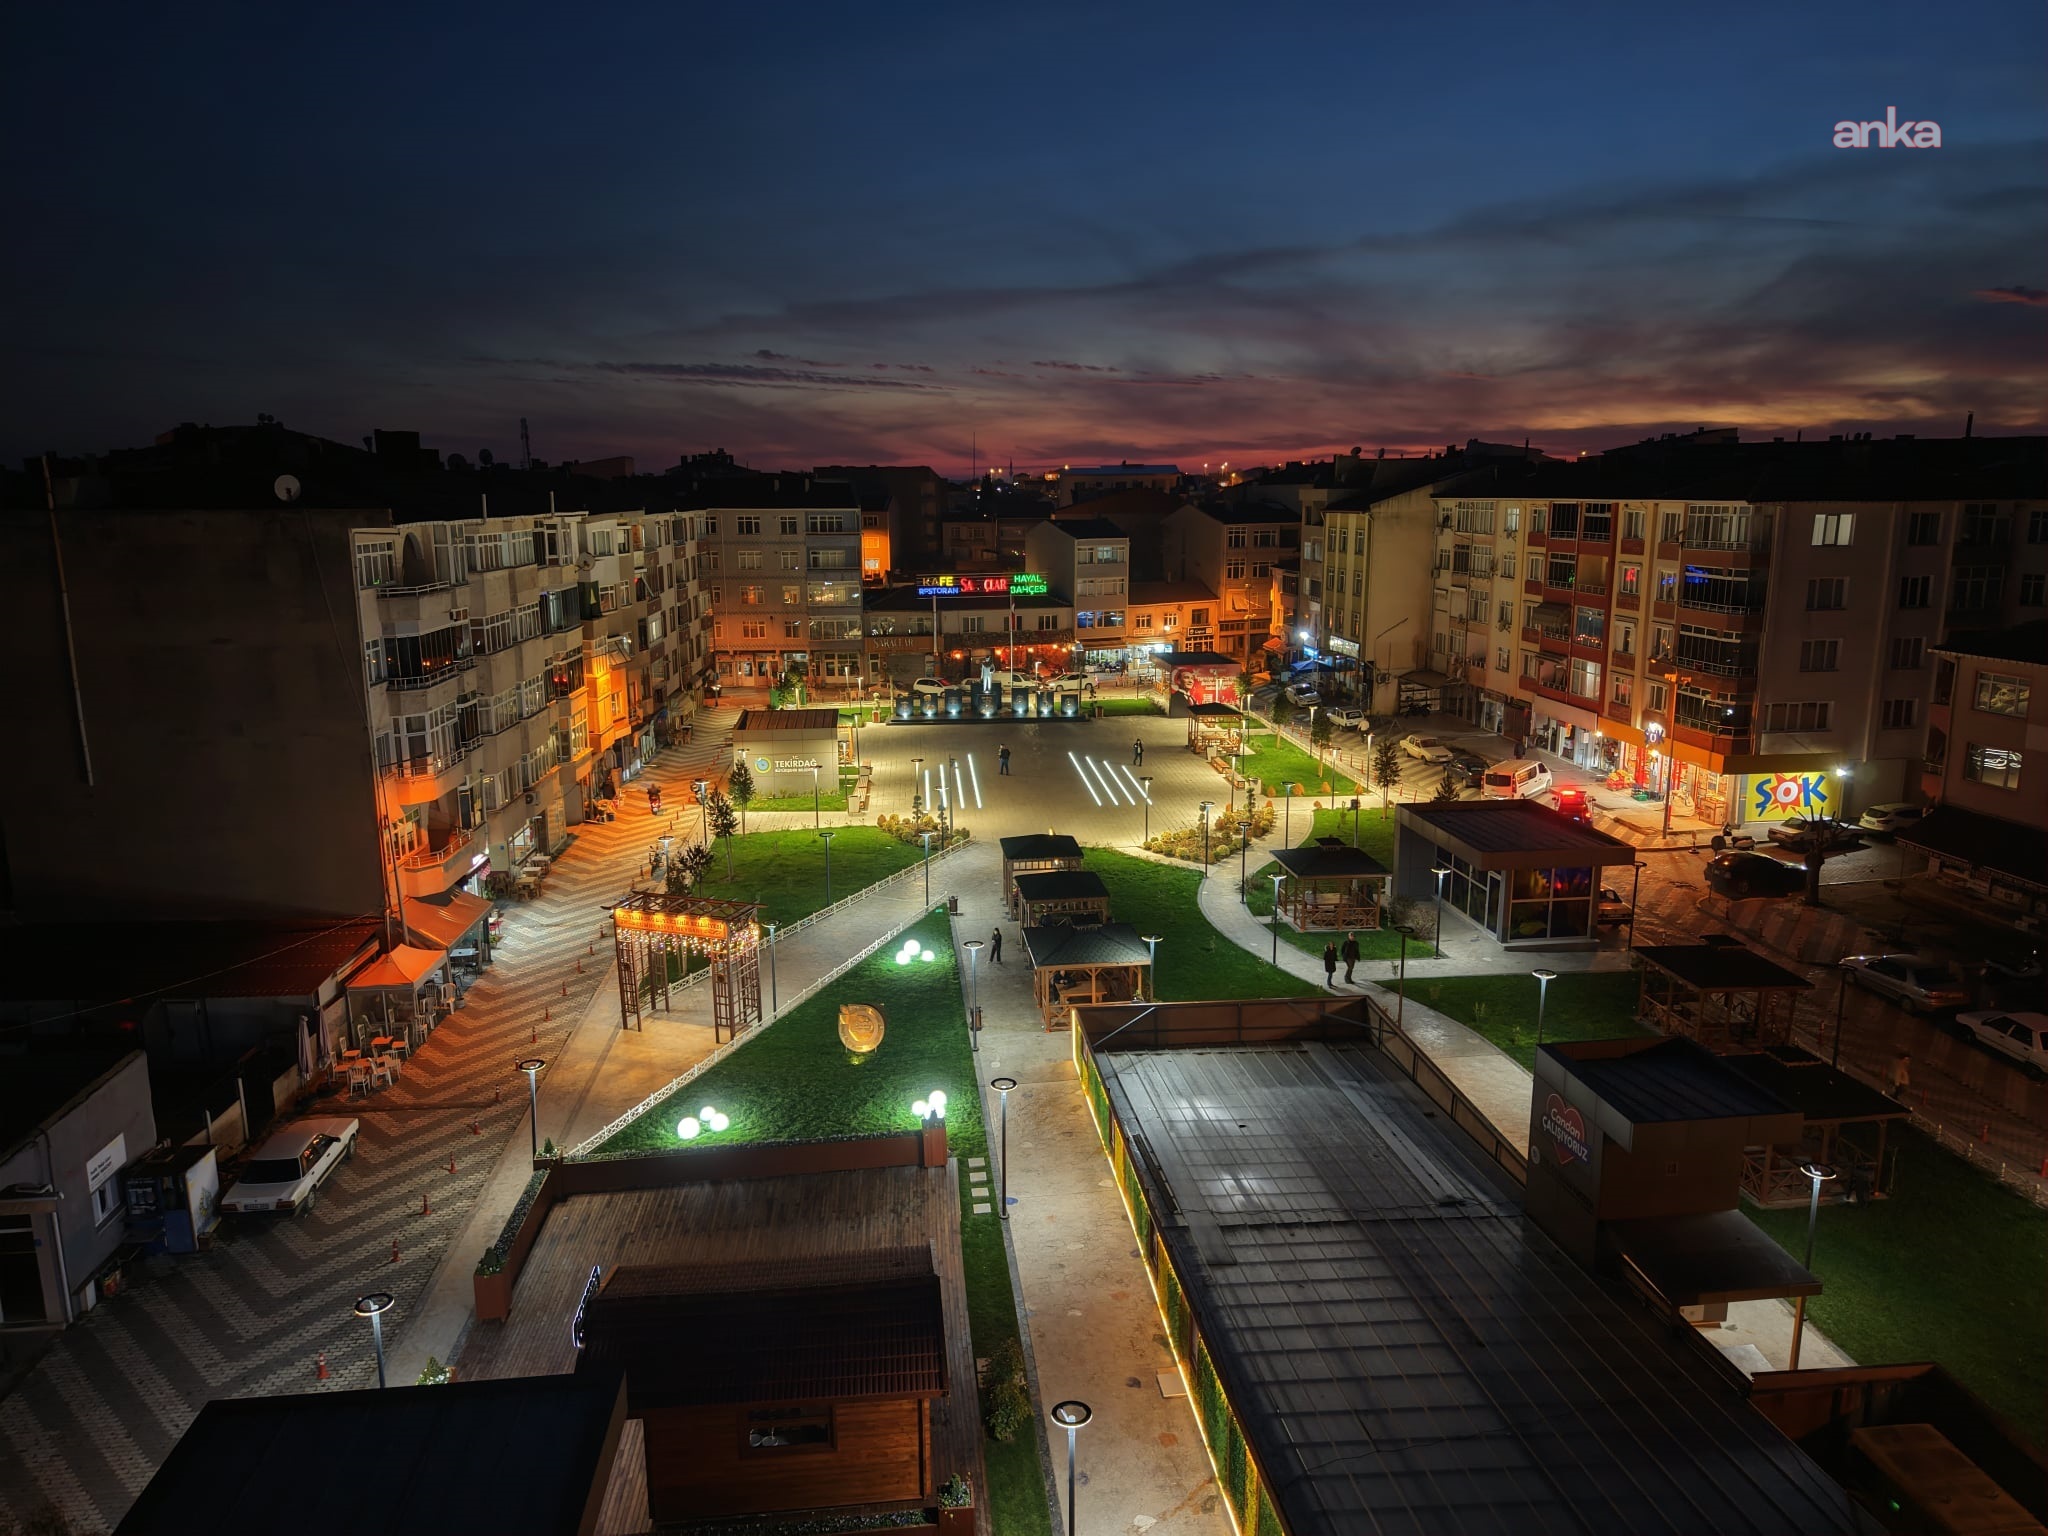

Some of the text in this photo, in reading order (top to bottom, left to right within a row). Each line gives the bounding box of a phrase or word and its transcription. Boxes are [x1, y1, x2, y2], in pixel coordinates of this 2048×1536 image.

[922, 576, 954, 587] KAFE
[1014, 574, 1042, 583] HAYAL
[775, 758, 817, 767] TEKİRDAĞ
[1755, 774, 1828, 817] ŞOK
[1550, 1108, 1580, 1139] Candan
[1542, 1115, 1588, 1161] ÇALIŞIYORUZ
